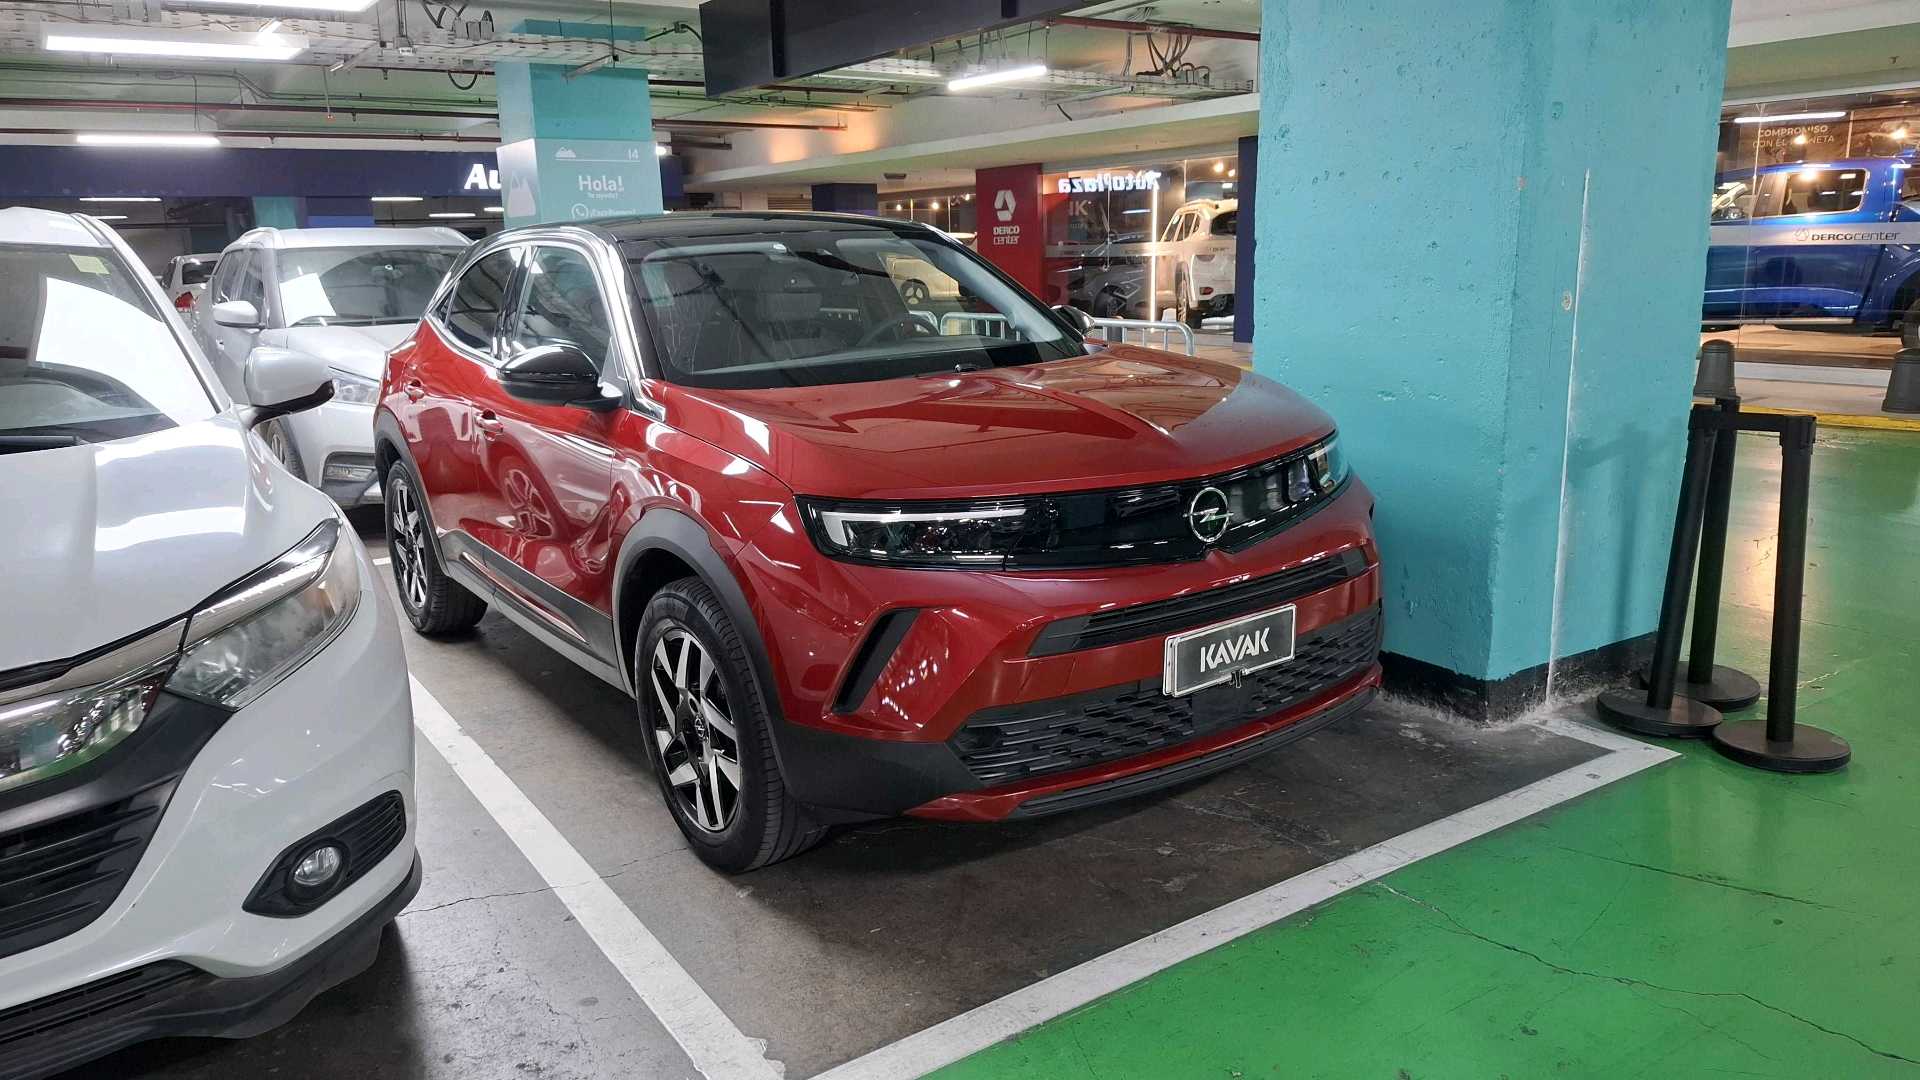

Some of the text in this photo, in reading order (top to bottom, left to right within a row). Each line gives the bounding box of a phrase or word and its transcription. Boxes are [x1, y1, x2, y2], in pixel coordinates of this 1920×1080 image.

[1759, 124, 1829, 138] COMPROMISO
[1752, 140, 1773, 149] CON
[1775, 139, 1786, 147] EL
[578, 175, 624, 192] Hola!
[993, 225, 1020, 235] DERCO
[993, 235, 1020, 246] center
[1200, 627, 1270, 673] KAVAK
